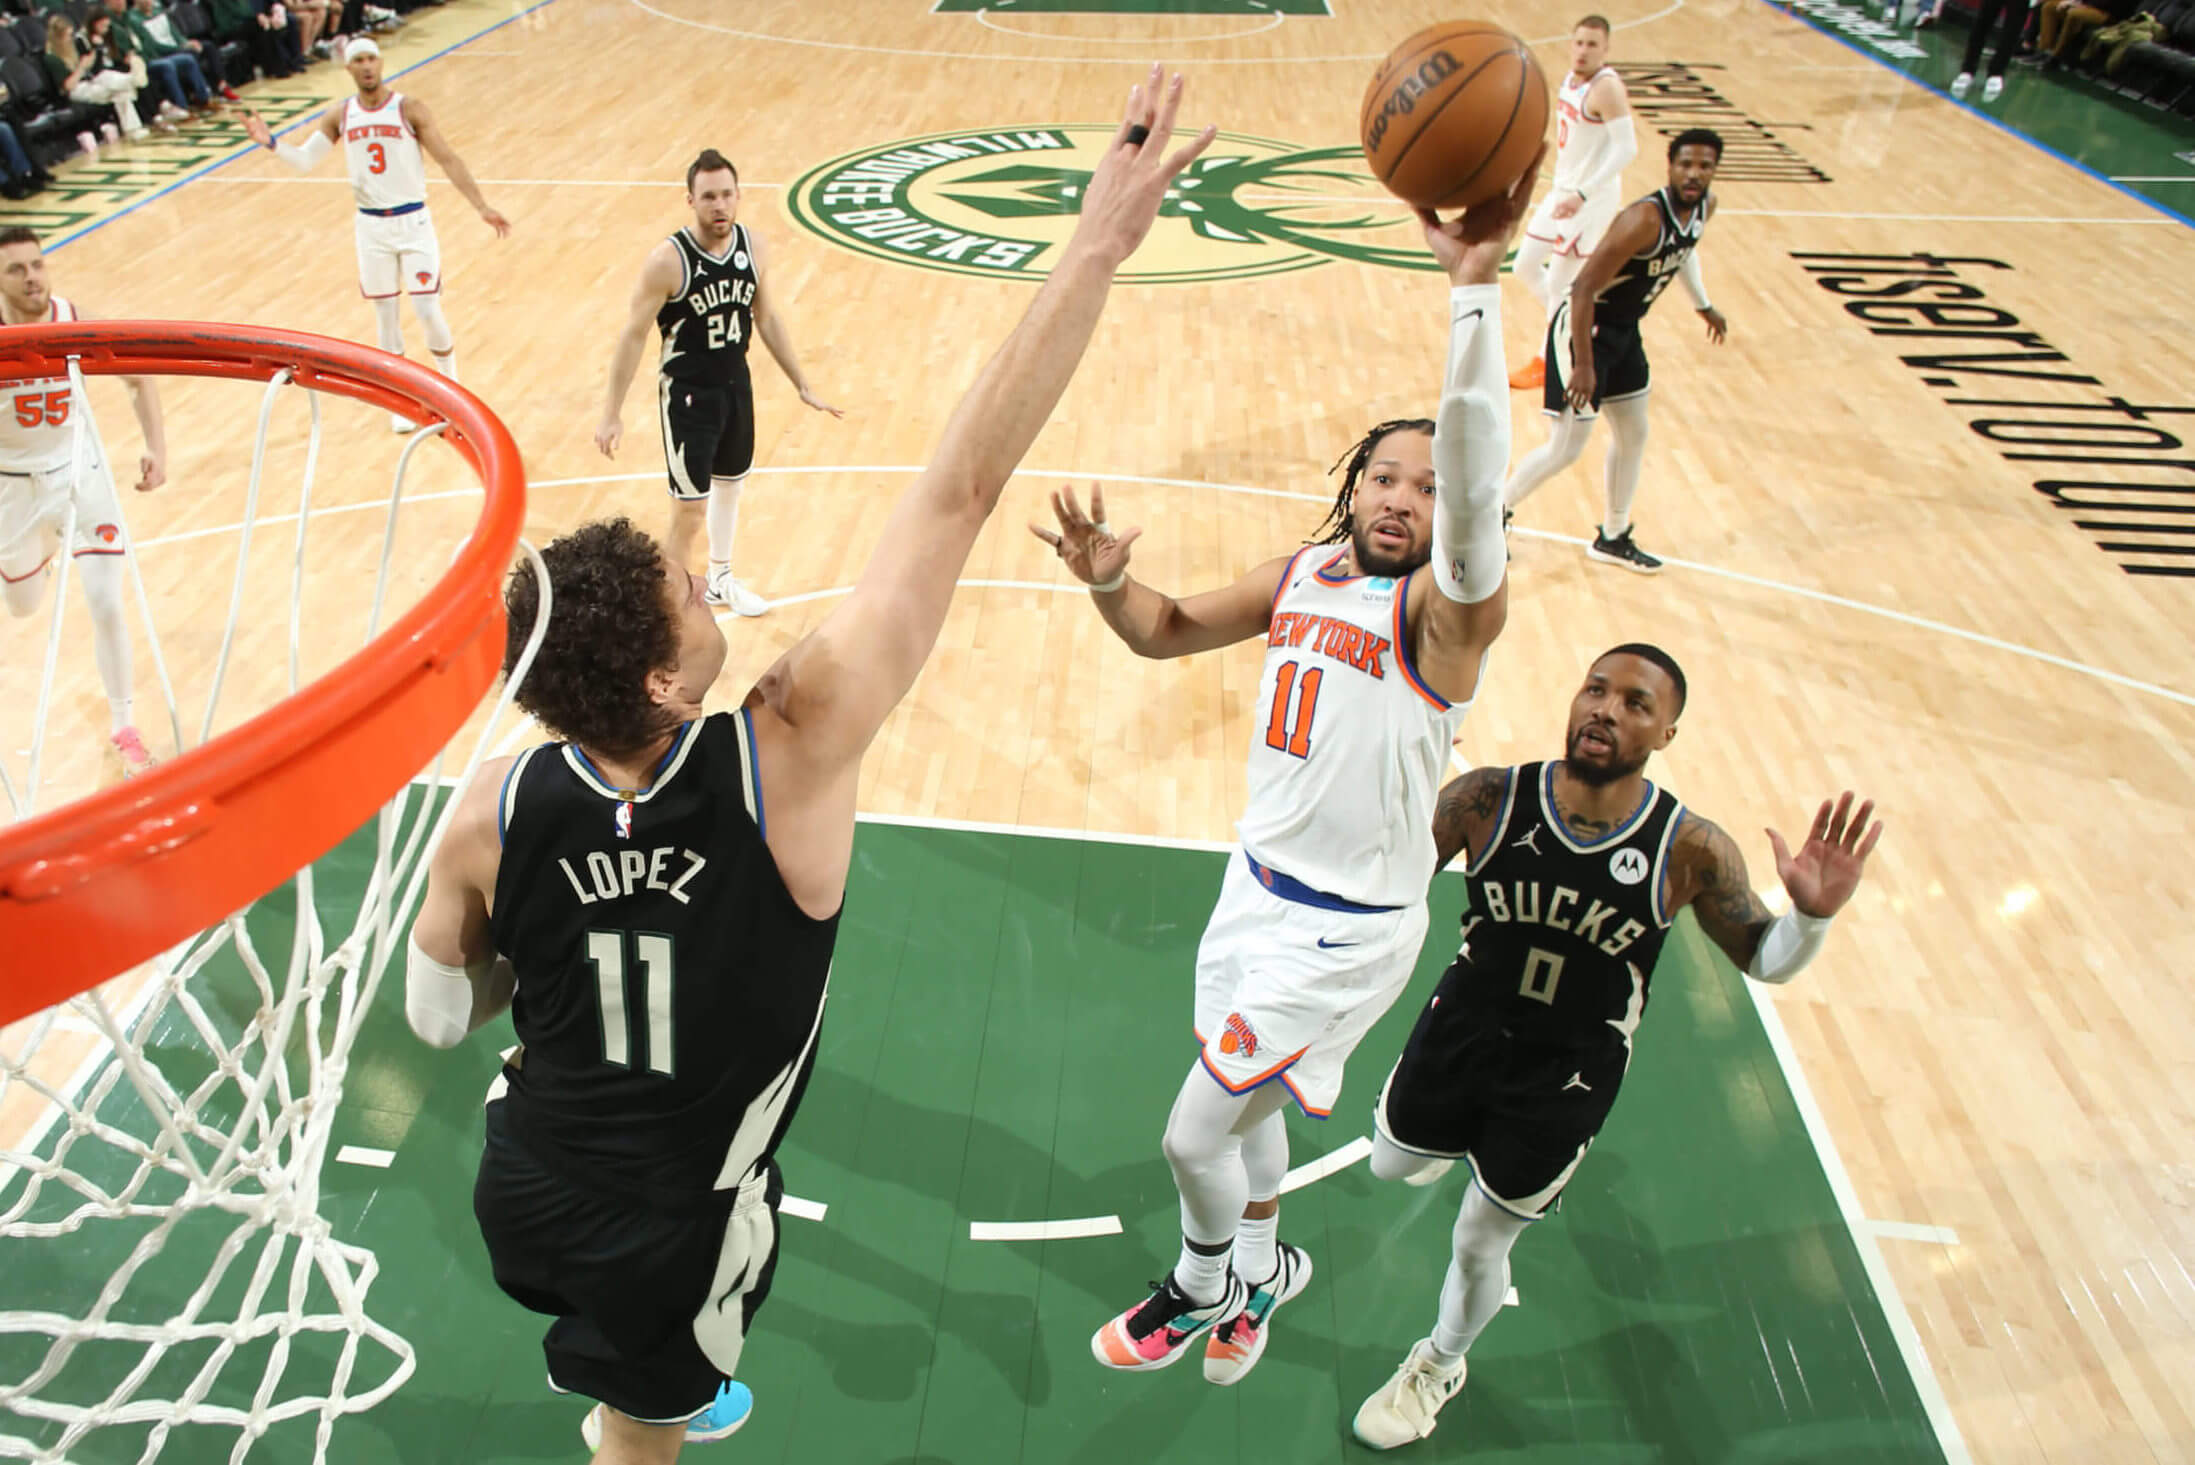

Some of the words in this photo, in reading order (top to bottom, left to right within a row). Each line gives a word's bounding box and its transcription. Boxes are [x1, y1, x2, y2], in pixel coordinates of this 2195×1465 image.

[1367, 50, 1464, 152] Wilson
[366, 142, 387, 175] 3
[823, 131, 1062, 205] MILWAUKEE
[832, 207, 1036, 268] BUCKS
[688, 279, 755, 317] BUCKS
[707, 310, 742, 350] 24
[14, 388, 71, 428] 55
[1312, 616, 1391, 681] YORK
[1266, 660, 1324, 760] 11
[558, 847, 706, 904] LOPEZ
[1483, 880, 1647, 957] BUCKS
[584, 928, 676, 1080] 11
[1518, 947, 1566, 1007] 0
